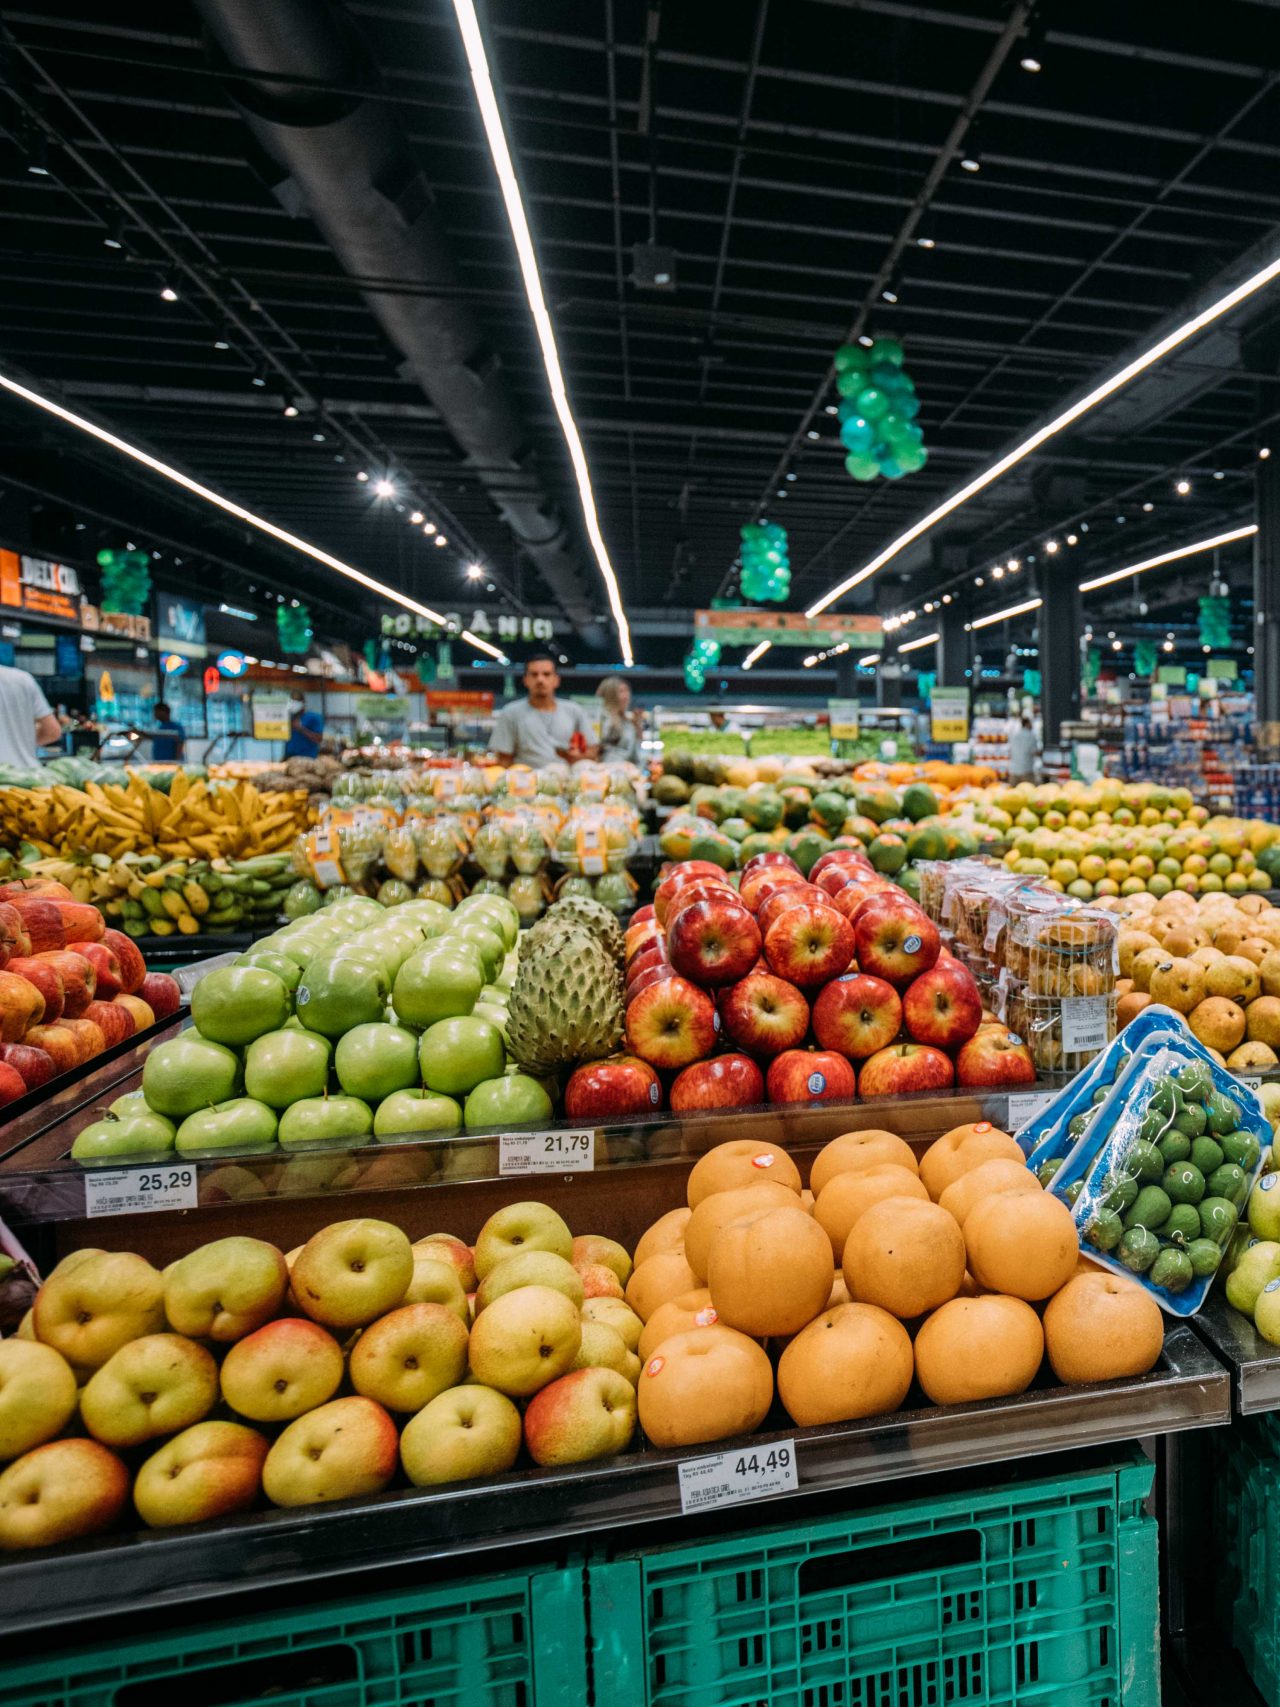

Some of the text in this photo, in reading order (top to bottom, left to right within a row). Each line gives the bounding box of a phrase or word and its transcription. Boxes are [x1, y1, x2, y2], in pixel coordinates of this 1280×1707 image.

[544, 1135, 590, 1154] 21,79
[139, 1171, 192, 1192] 25,29
[735, 1448, 790, 1476] 44,49
